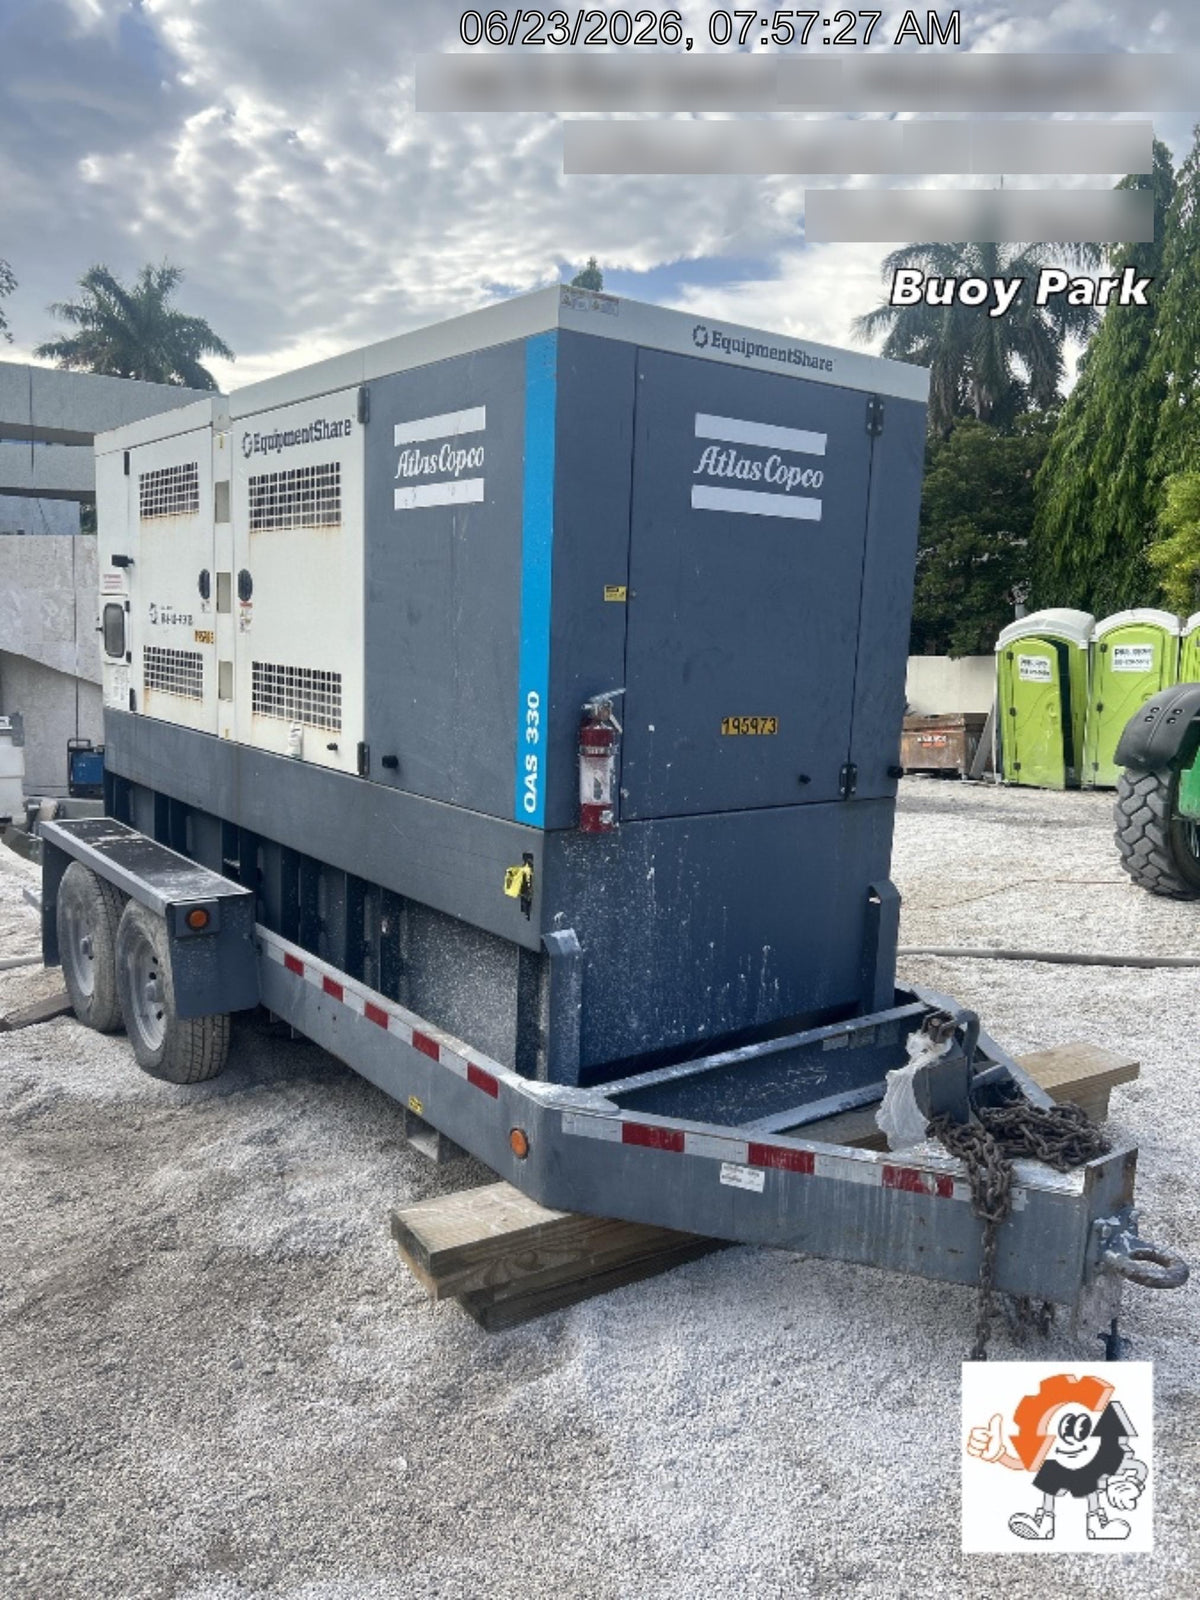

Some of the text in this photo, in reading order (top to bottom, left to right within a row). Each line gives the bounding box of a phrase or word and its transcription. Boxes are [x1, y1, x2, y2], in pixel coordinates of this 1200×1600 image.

[711, 330, 833, 372] EquipmentShare
[253, 419, 352, 455] EquipmentShare
[394, 443, 484, 479] Atlas Copco
[693, 445, 824, 492] Atlas Copco
[525, 691, 540, 744] 330
